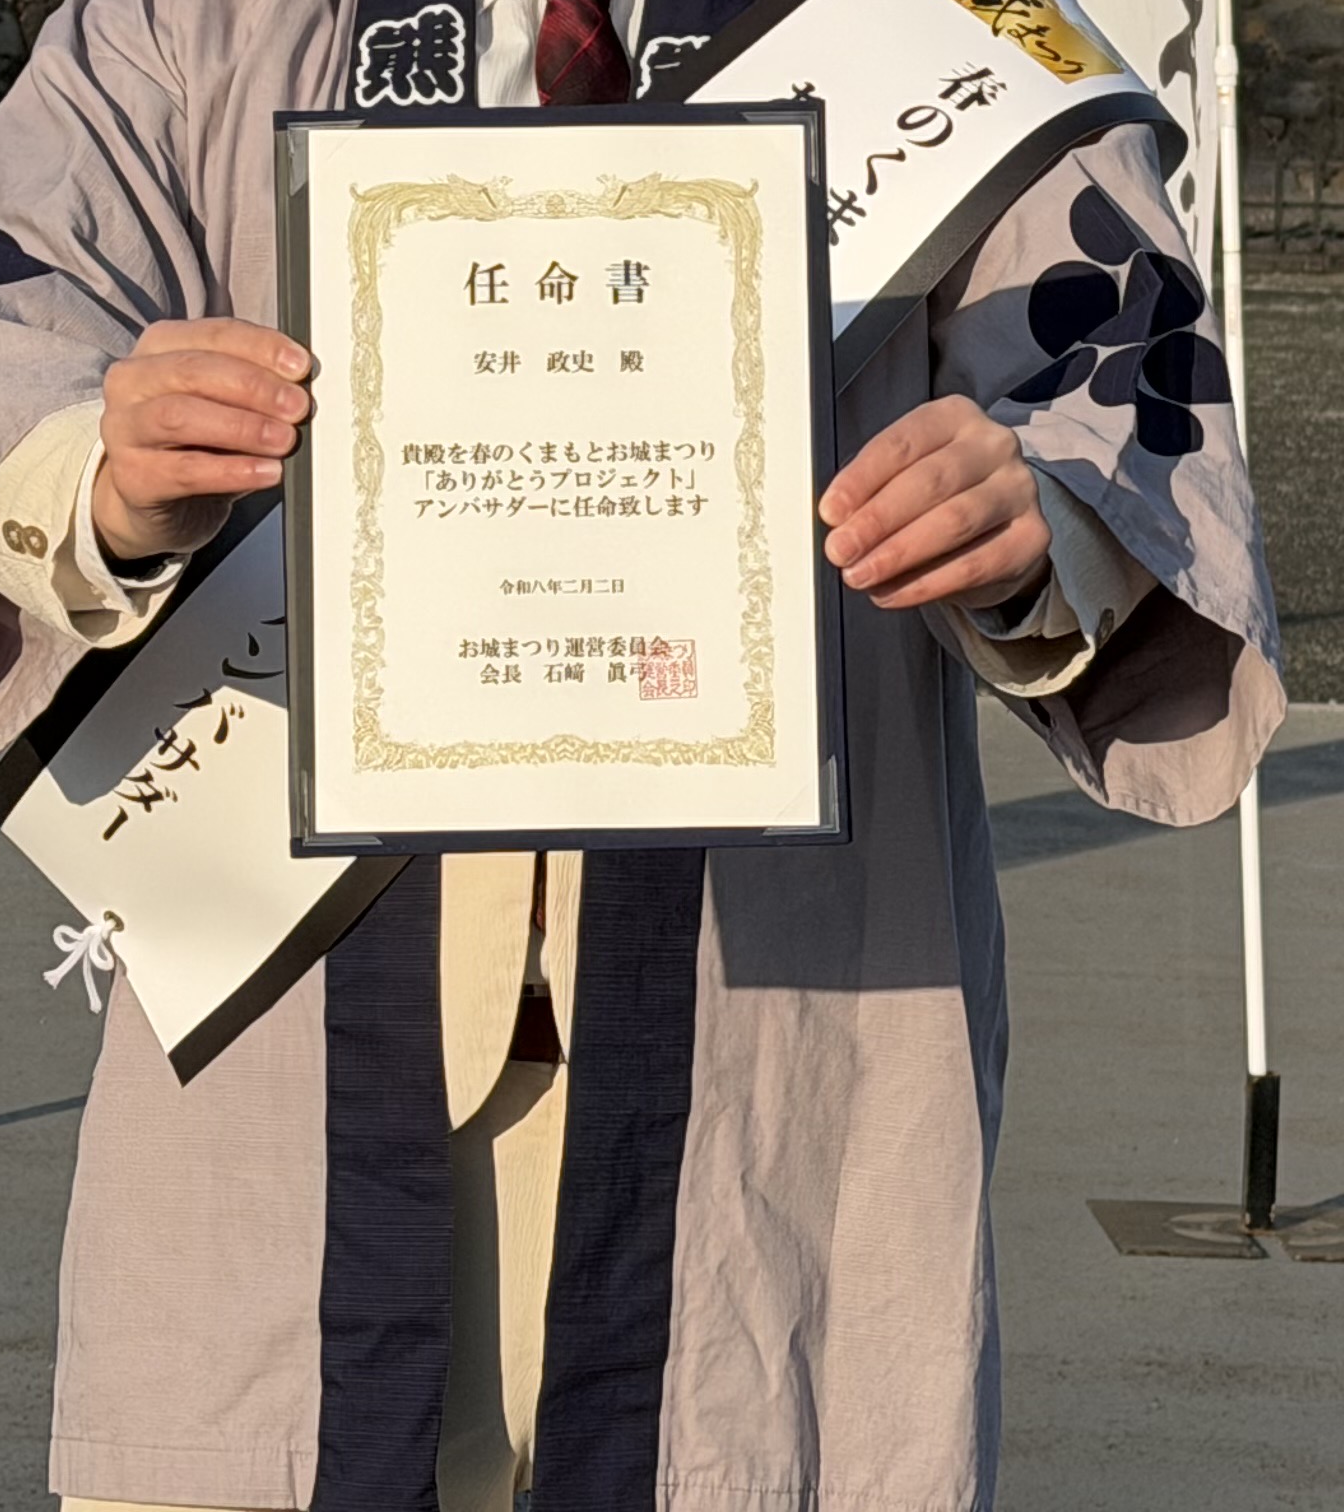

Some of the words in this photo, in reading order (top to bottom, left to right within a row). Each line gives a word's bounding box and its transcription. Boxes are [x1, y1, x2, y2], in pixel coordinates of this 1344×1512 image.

[355, 4, 465, 107] 熊
[473, 350, 522, 374] 安井
[546, 349, 595, 374] 政史
[619, 349, 645, 373] 殿
[400, 439, 716, 466] 貴殿を春のくまもとお城まつり
[423, 467, 697, 492] 「ありがとうプロジェクト」
[413, 494, 710, 520] アンバサダーに任命致します
[499, 578, 625, 596] 令和八年二月二日
[458, 635, 673, 659] お城まつり運営委員会
[479, 663, 522, 684] 会長
[103, 615, 286, 841] ンバサダー
